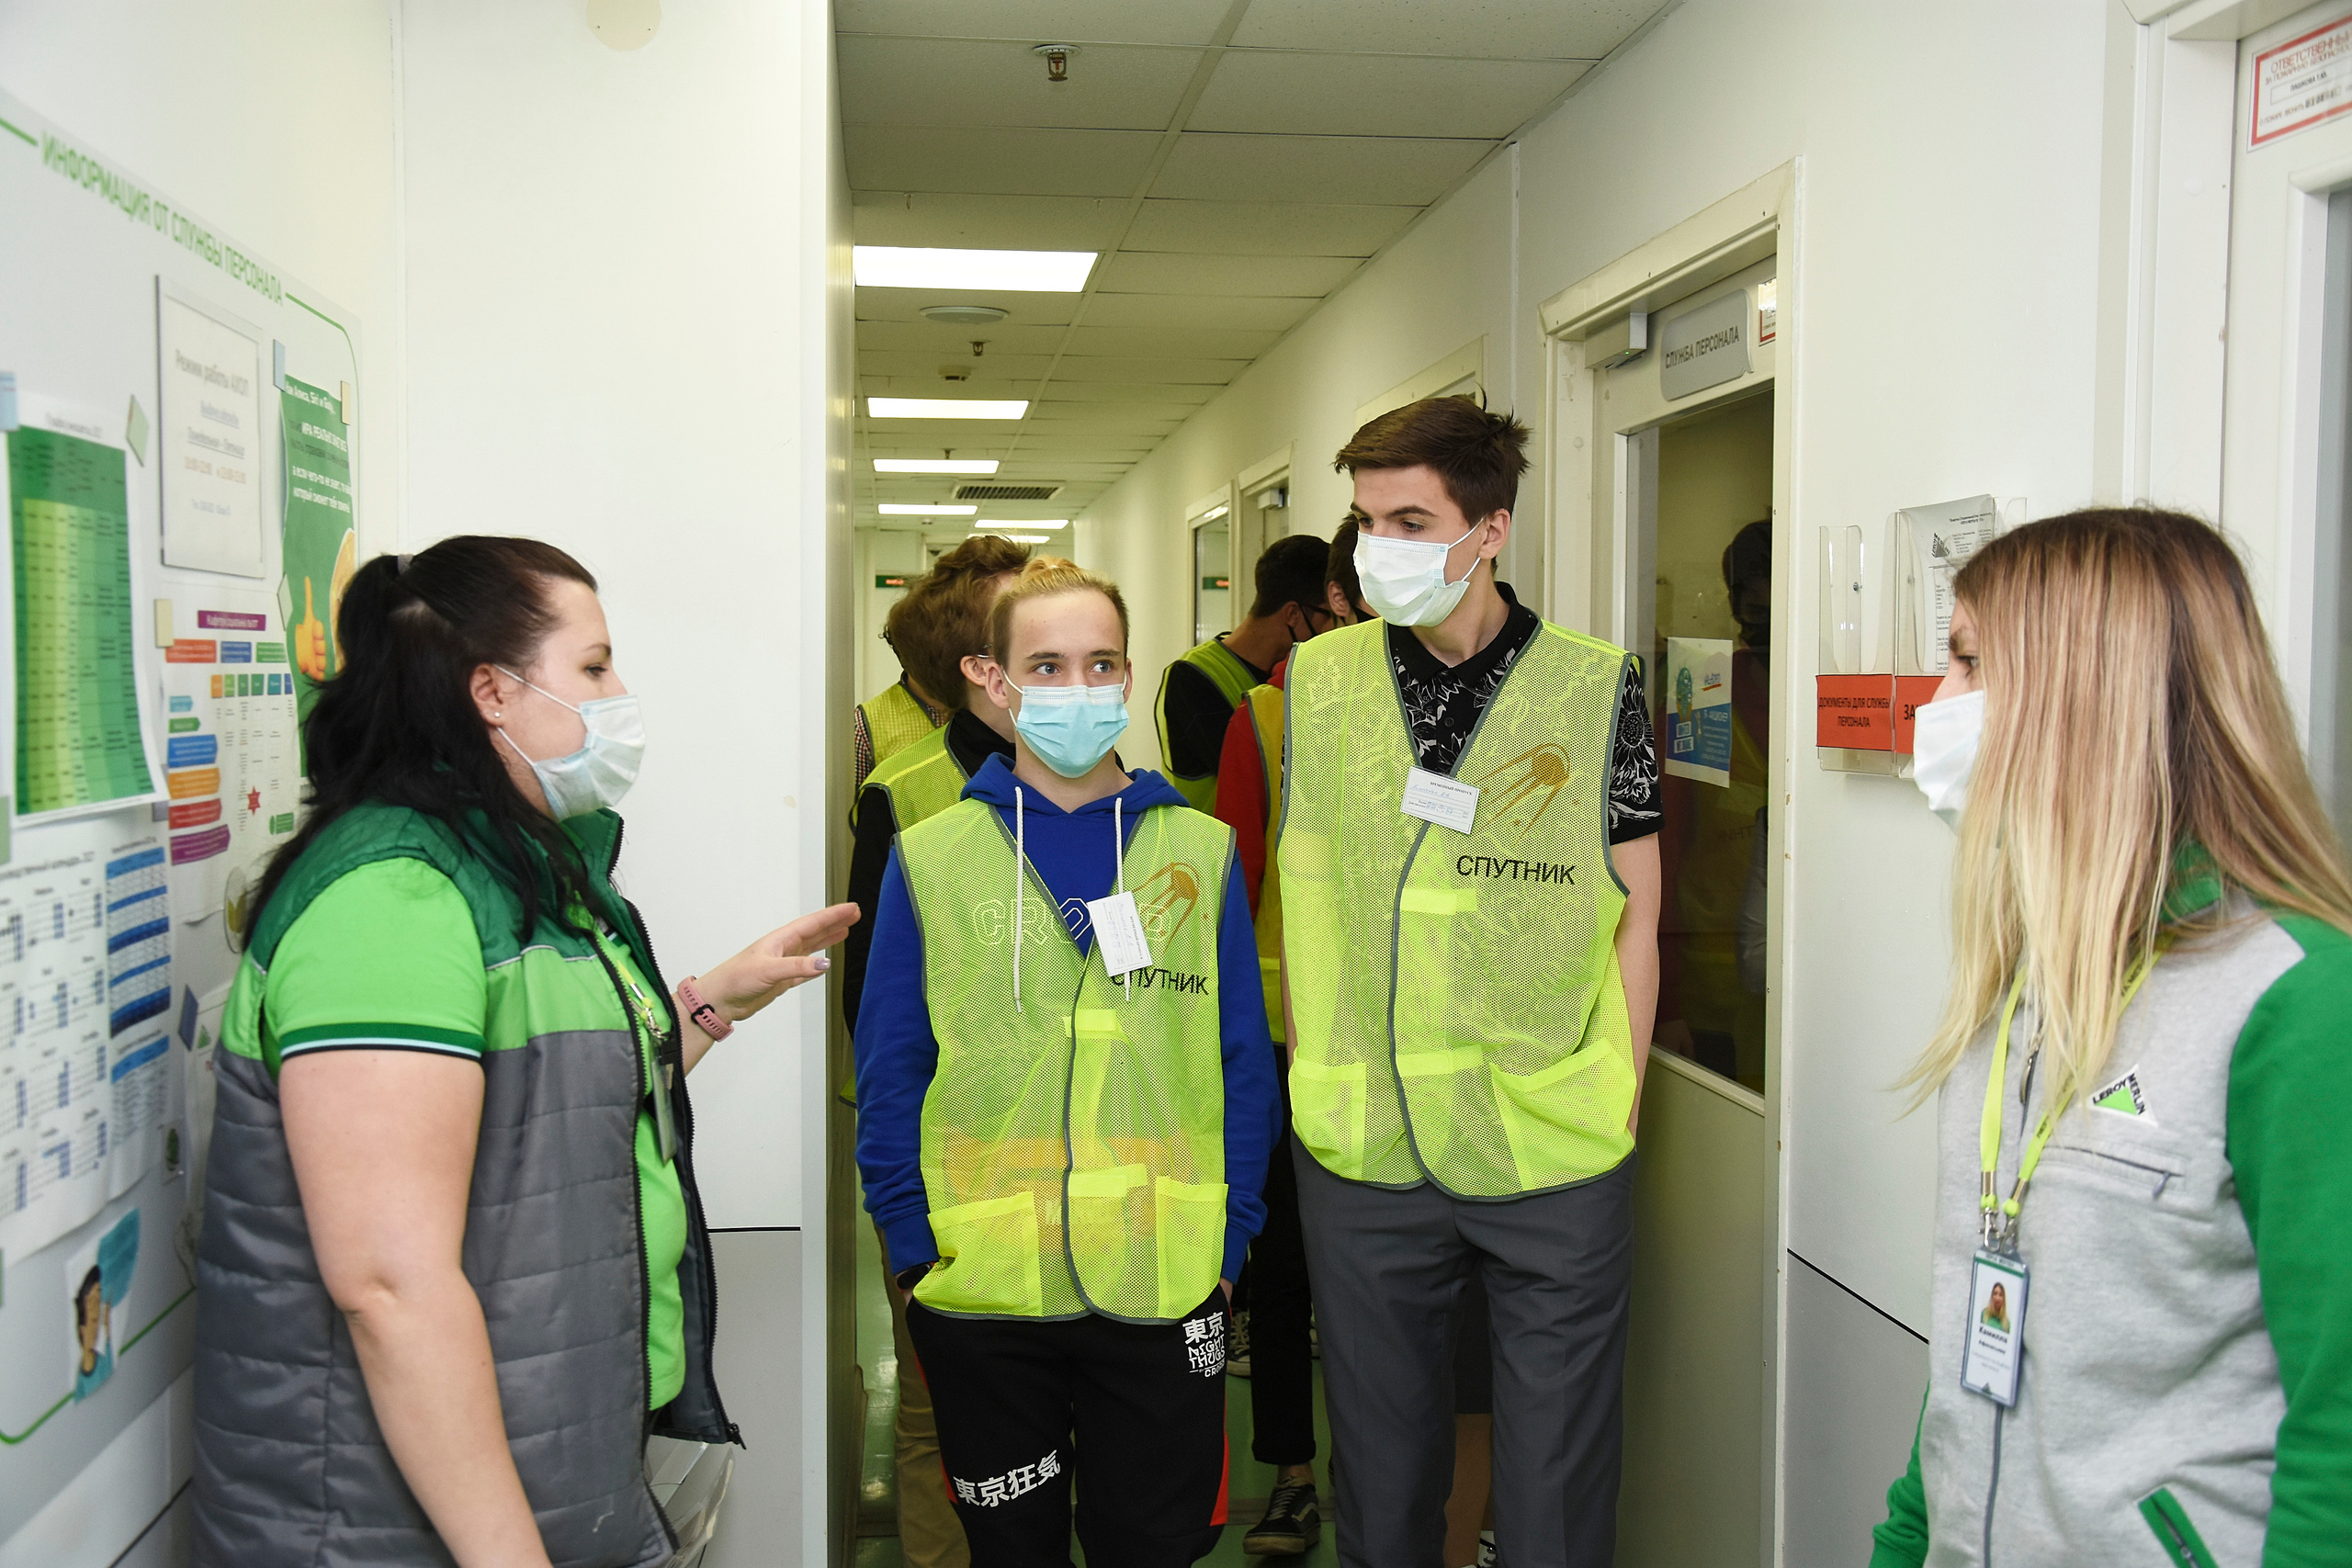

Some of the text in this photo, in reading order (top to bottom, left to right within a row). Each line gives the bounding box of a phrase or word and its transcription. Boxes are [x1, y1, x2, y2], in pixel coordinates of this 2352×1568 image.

[42, 130, 283, 307] ИНФОРМАЦИЯ ОТ СЛУЖБЫ ПЕРСОНАЛА
[1665, 325, 1739, 369] СЛУЖБА ПЕРСОНАЛА
[1818, 697, 1890, 710] ДОКУМЕНТЫ ДЛЯ СЛУЖБЫ
[1838, 716, 1870, 728] ПЕРСОНАЛА
[1456, 855, 1576, 885] СПУТНИК
[2093, 1079, 2127, 1104] LEROY
[2128, 1073, 2146, 1115] MERLIN
[1182, 1312, 1225, 1344] 東京
[1188, 1334, 1225, 1359] NIGHT
[1189, 1346, 1226, 1370] THUGS
[953, 1450, 1061, 1507] 東京狂気
